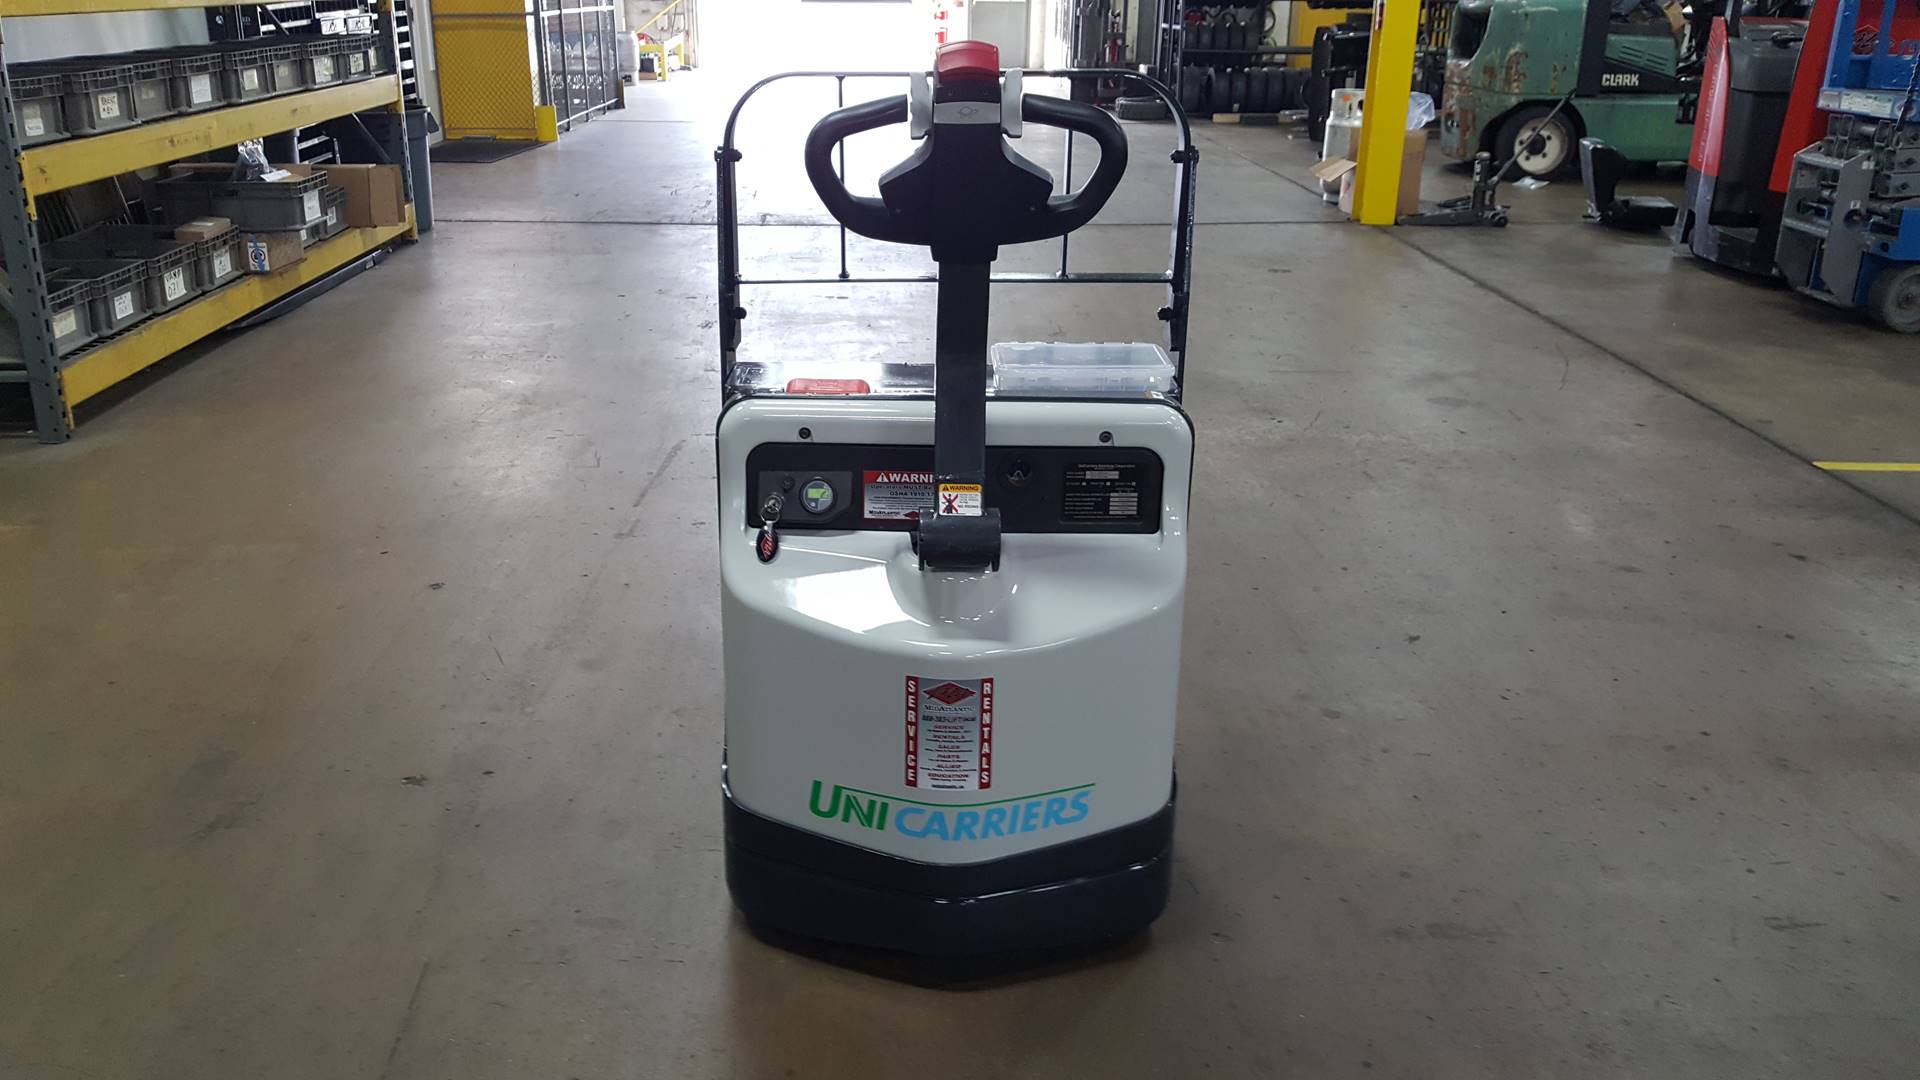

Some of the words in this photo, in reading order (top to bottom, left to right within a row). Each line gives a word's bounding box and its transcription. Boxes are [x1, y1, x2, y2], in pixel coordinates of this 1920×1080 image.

[1601, 73, 1640, 87] CLARK
[889, 473, 935, 483] WARNI
[906, 679, 917, 781] SERVICE
[980, 682, 992, 784] RENTALS
